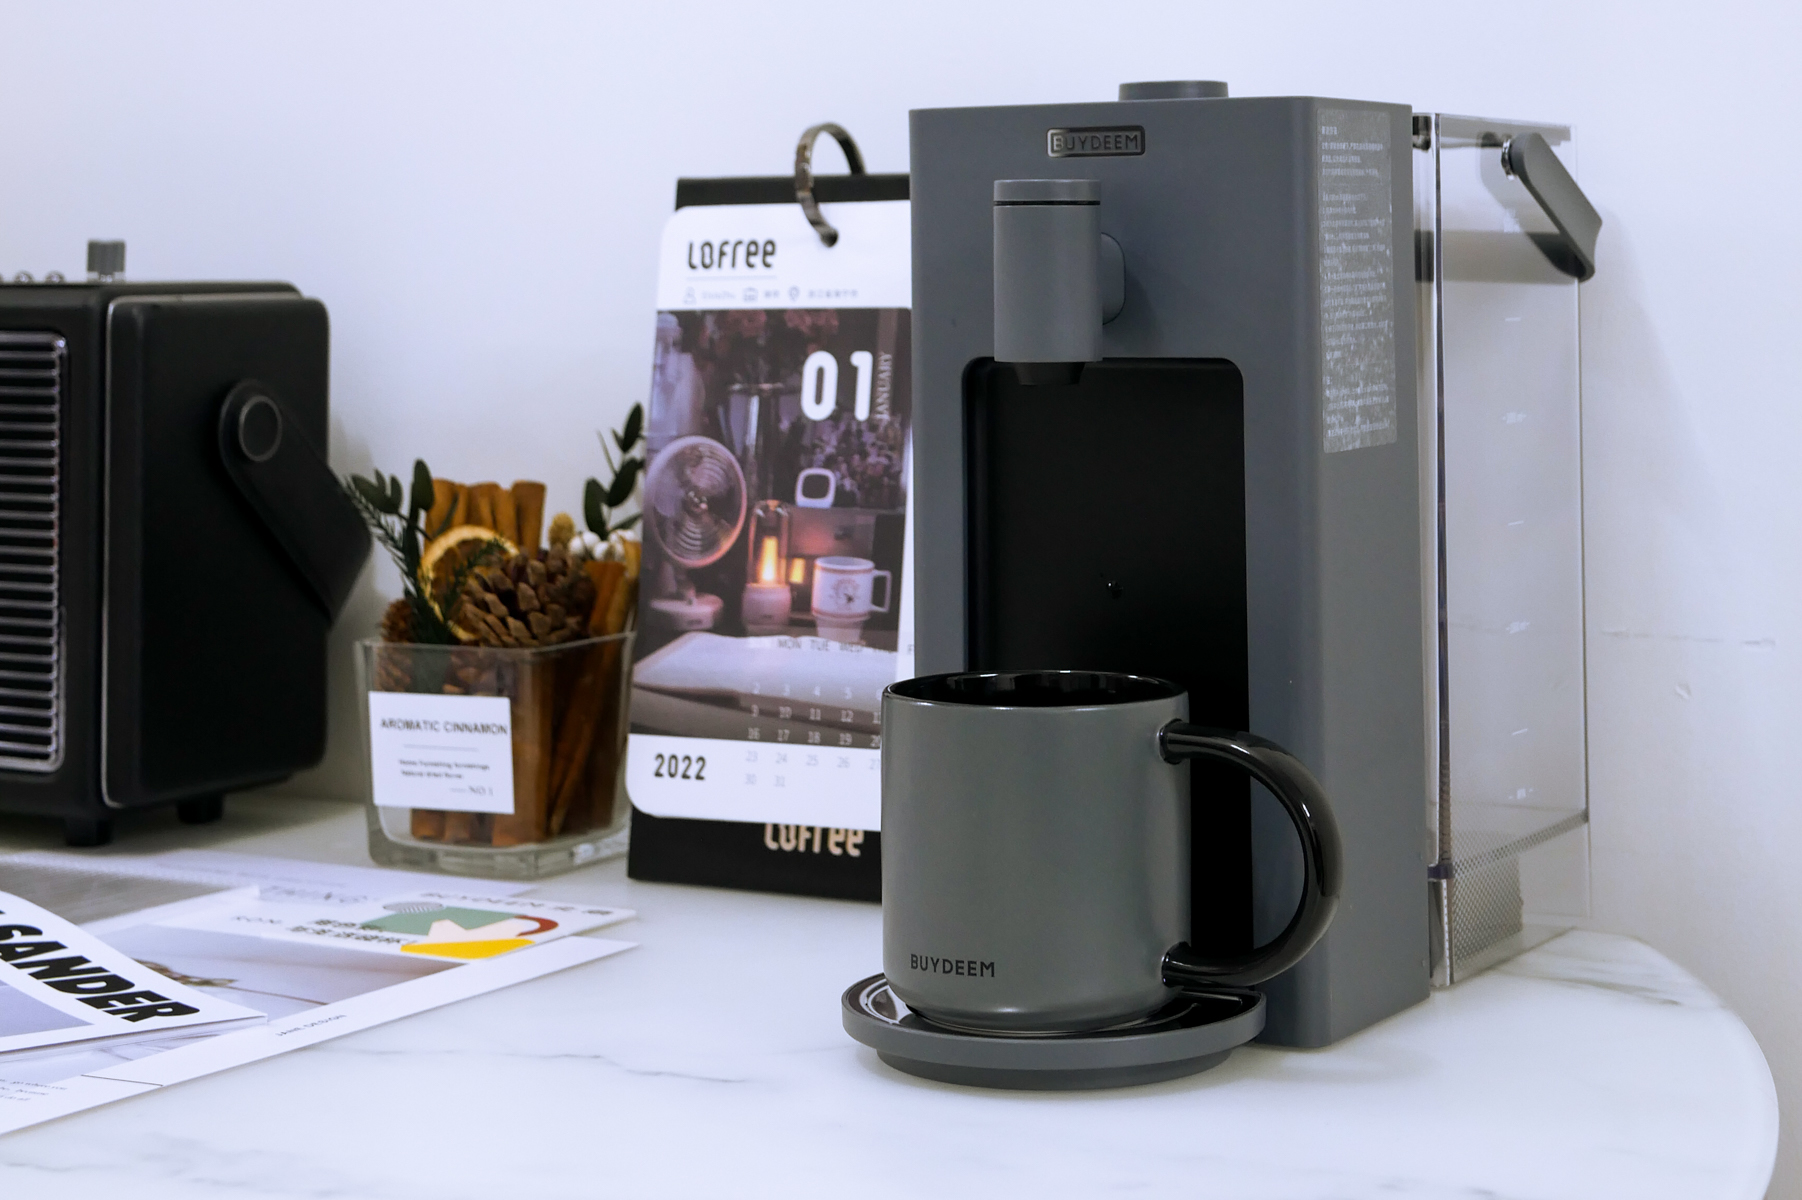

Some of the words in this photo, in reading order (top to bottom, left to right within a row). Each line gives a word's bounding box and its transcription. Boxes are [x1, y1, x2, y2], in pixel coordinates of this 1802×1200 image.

[1052, 134, 1138, 151] BUYDEEM
[801, 350, 873, 421] 01
[778, 638, 802, 650] MON
[841, 710, 854, 723] 12
[380, 718, 441, 732] AROMATIC
[443, 720, 508, 735] CINNAMON
[654, 753, 707, 781] 2022
[910, 953, 995, 978] BUYDEEM
